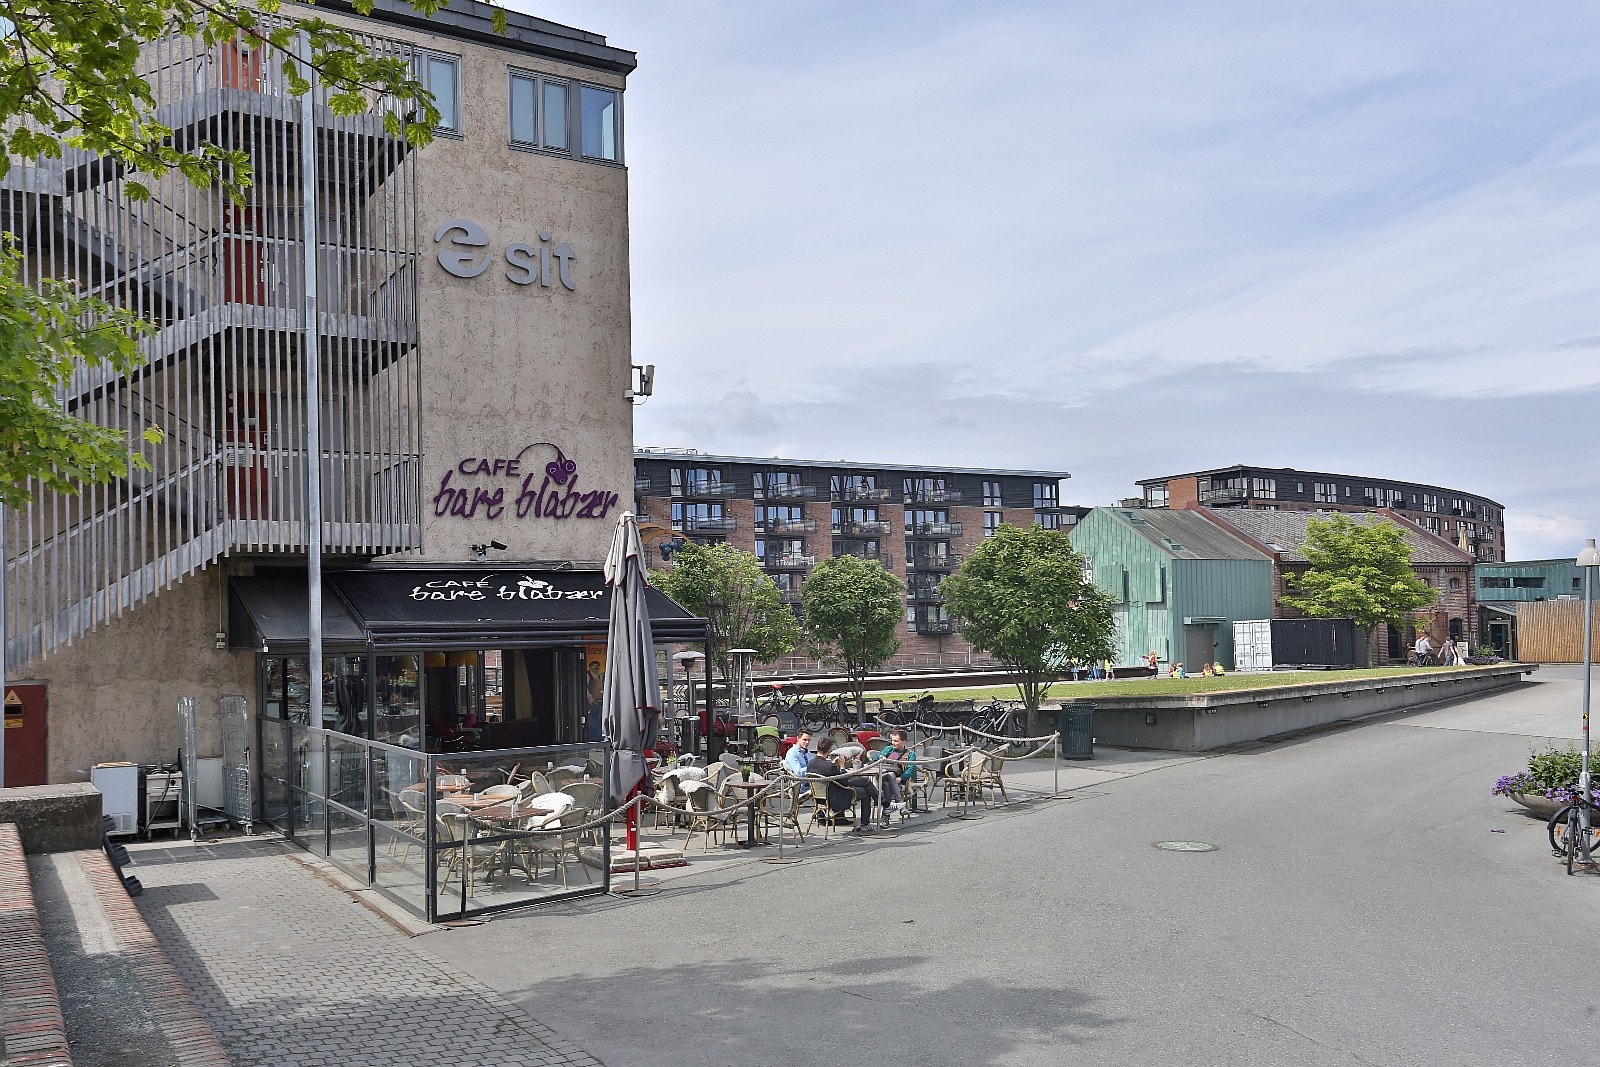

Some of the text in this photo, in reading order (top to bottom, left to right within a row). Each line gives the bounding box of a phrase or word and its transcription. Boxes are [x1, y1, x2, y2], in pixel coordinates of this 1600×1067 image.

[504, 231, 576, 291] sit
[434, 469, 505, 520] bare
[409, 586, 487, 601] bare
